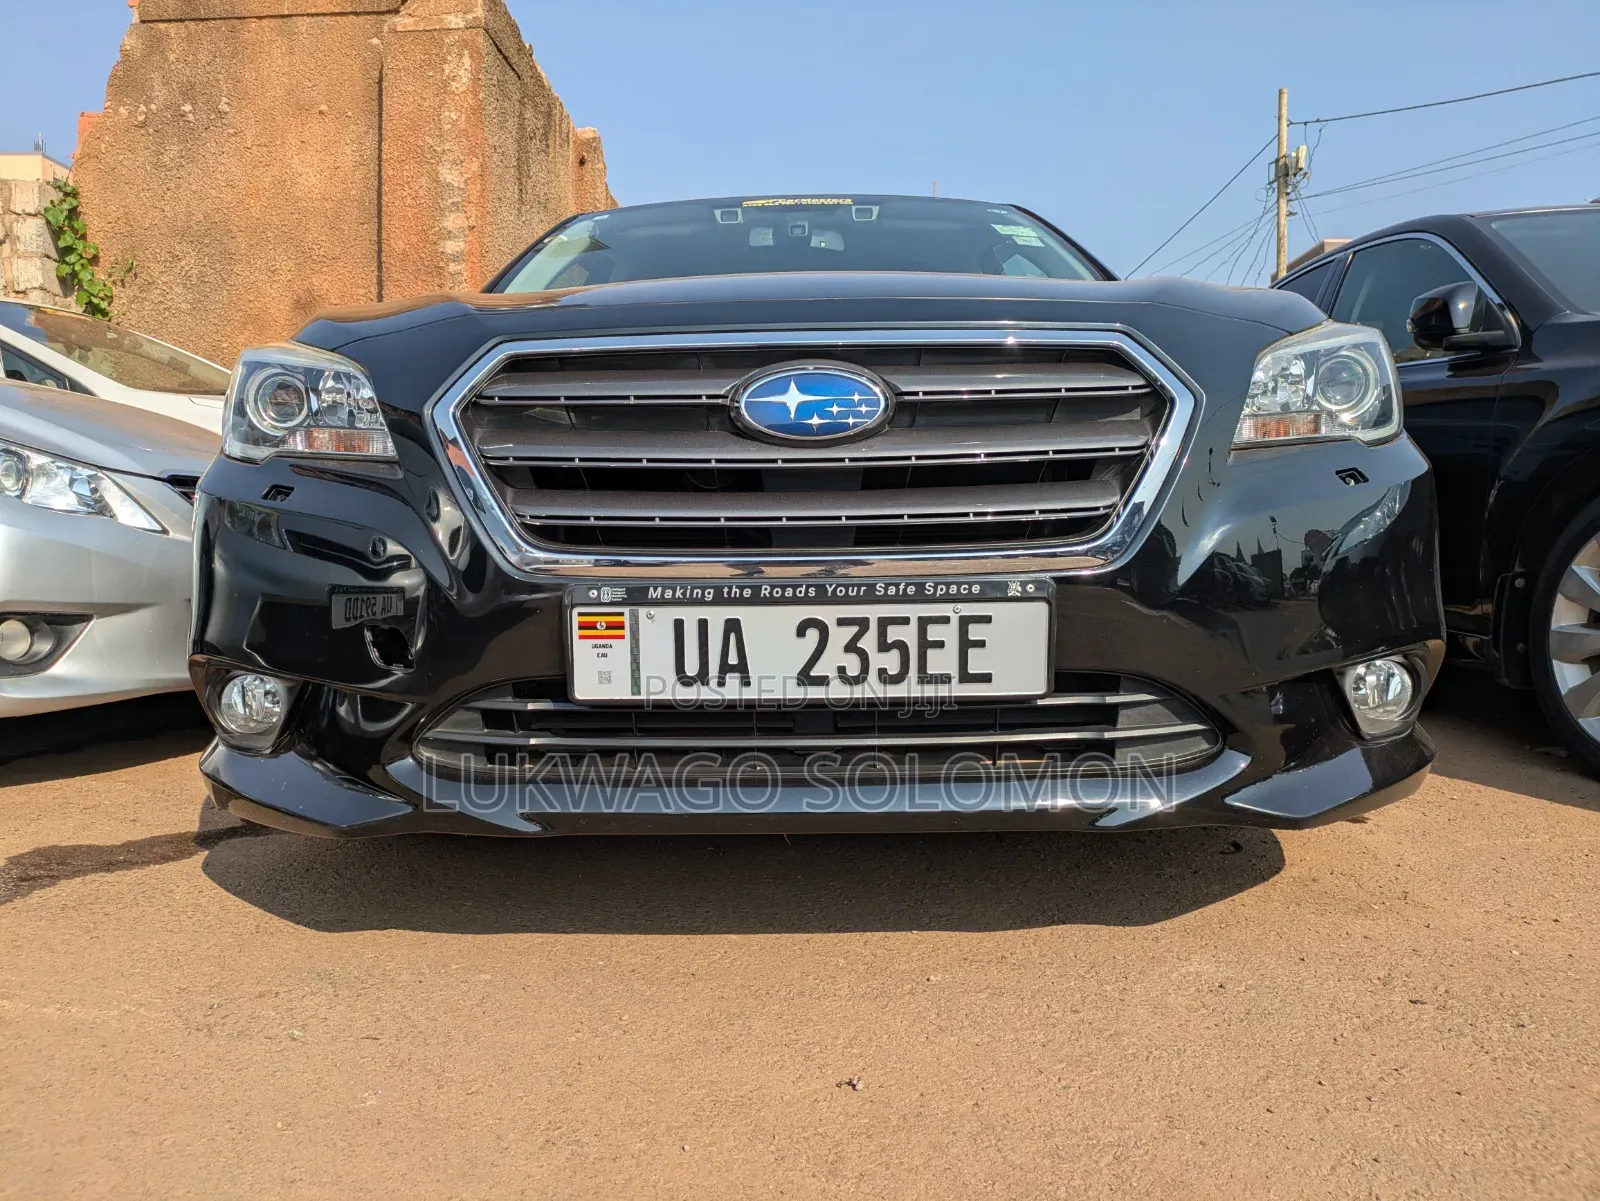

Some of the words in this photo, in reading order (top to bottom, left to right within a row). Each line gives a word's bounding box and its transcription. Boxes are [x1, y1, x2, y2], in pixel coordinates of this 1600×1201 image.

[648, 586, 714, 601] Making
[723, 585, 752, 598] the
[761, 585, 816, 597] Roads
[825, 584, 867, 596] Your
[875, 583, 916, 596] Safe
[924, 582, 981, 597] Space
[673, 617, 752, 687] UA
[796, 615, 993, 687] 235EE
